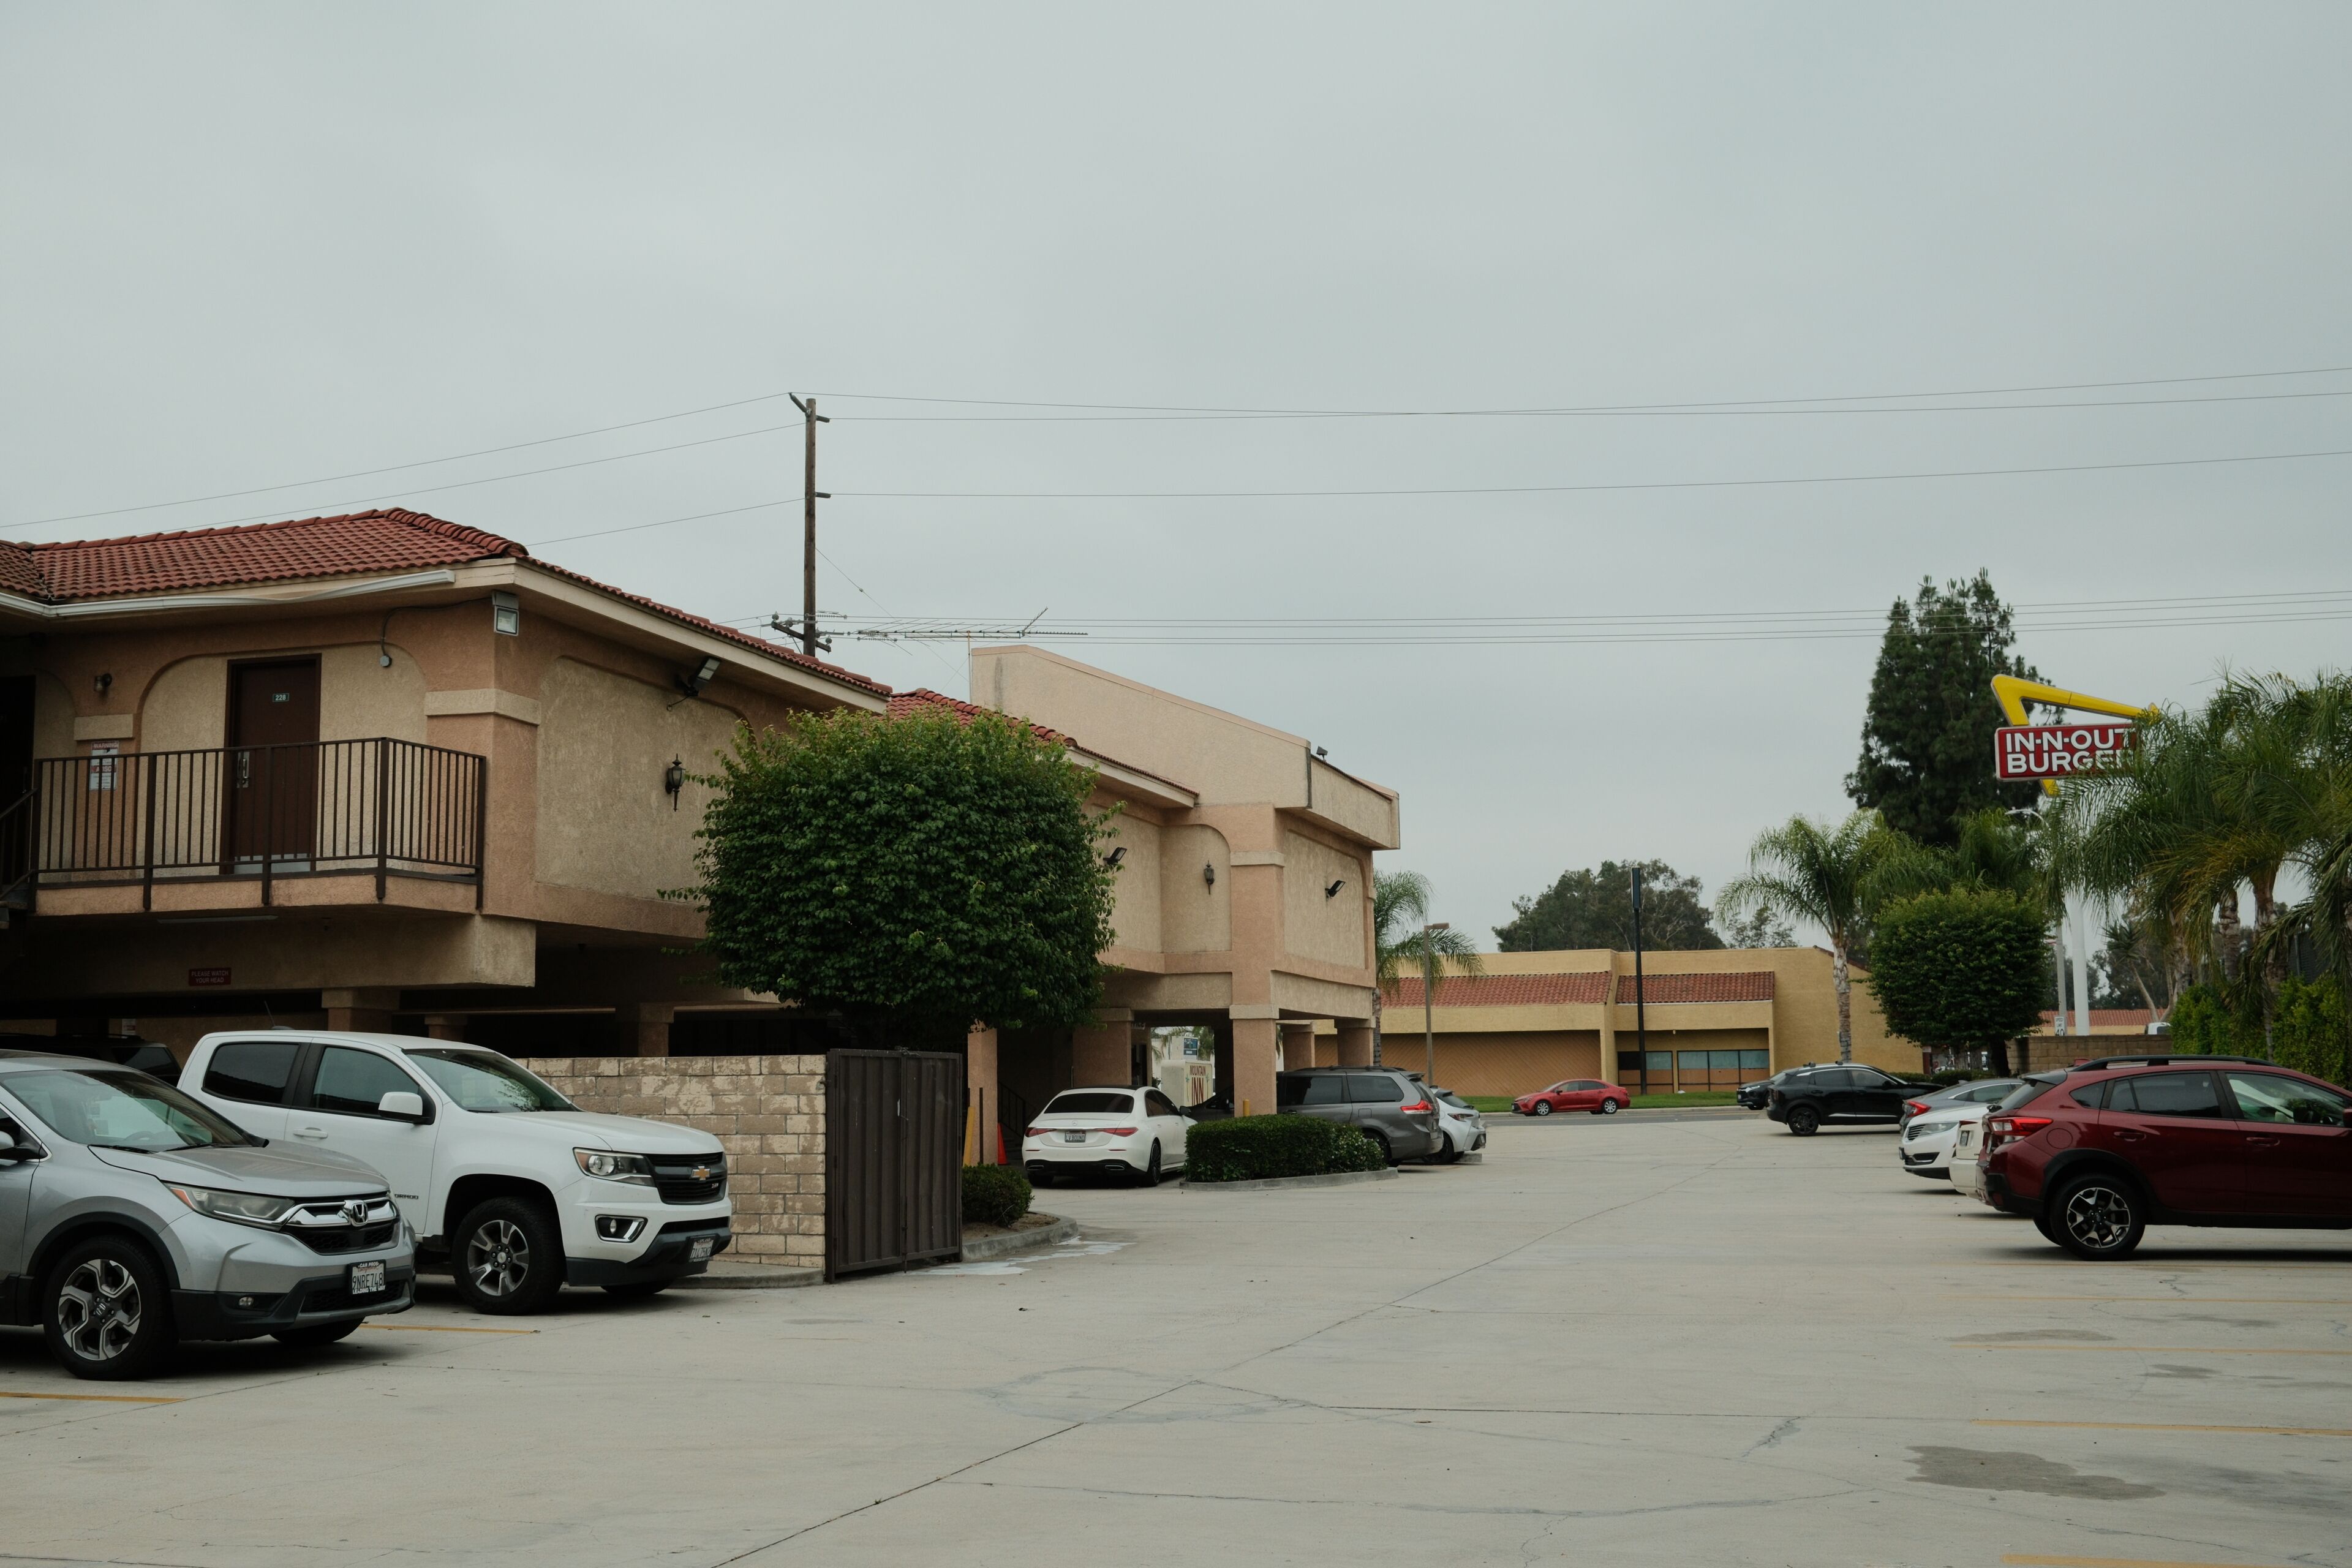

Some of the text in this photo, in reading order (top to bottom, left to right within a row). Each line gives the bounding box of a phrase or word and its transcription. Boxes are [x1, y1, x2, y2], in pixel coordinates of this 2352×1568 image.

[2006, 728, 2136, 753] IN-N-OUT
[1189, 1065, 1206, 1076] MOUNTAIN
[1191, 1077, 1204, 1106] INN
[352, 1272, 383, 1290] 9NRE748
